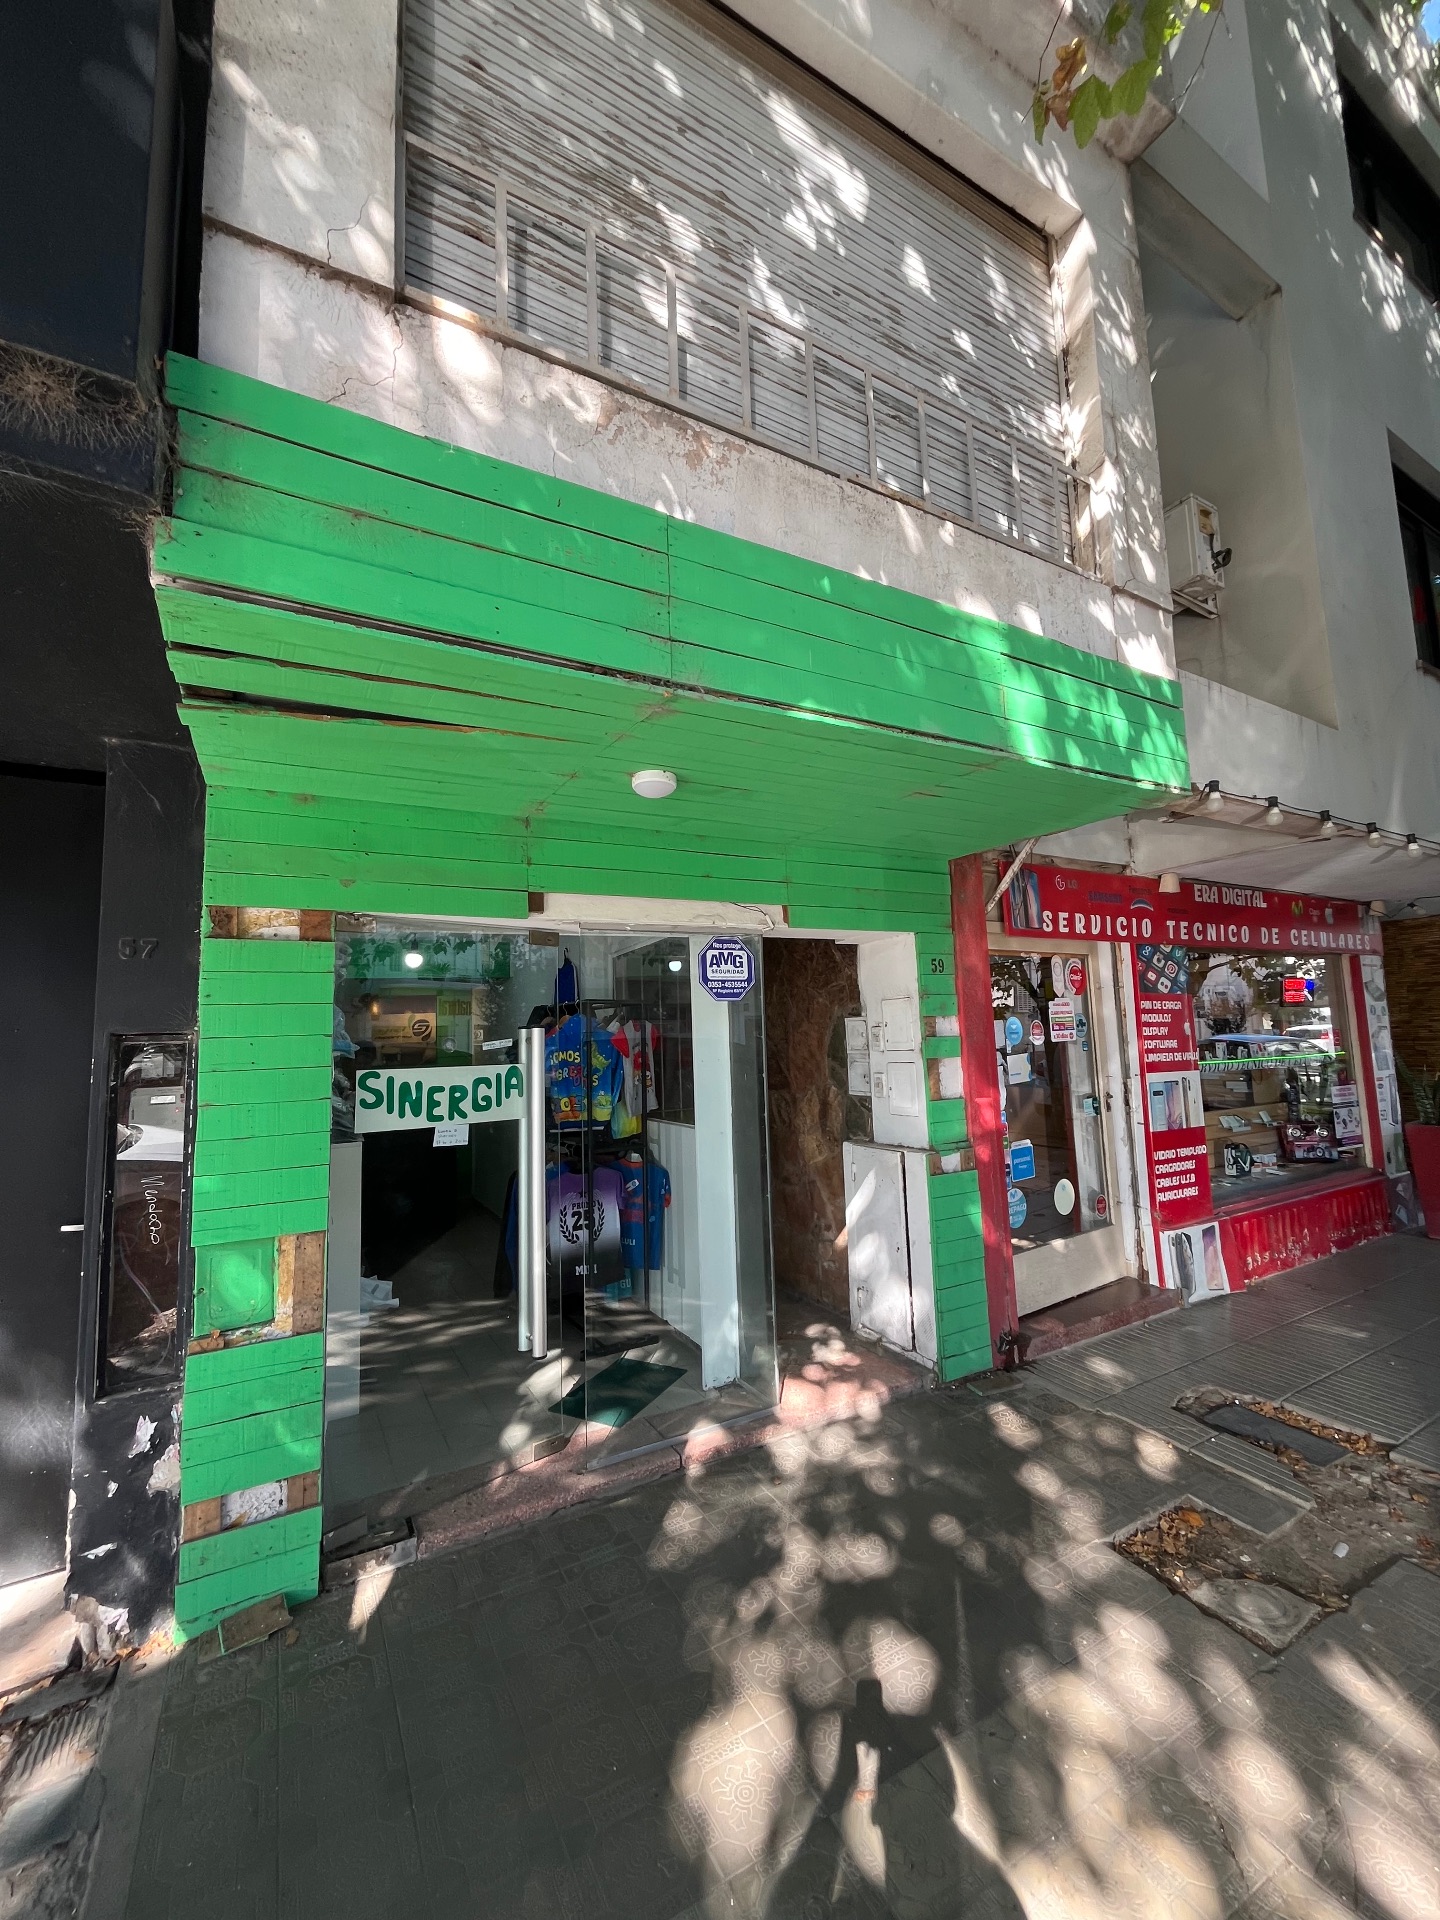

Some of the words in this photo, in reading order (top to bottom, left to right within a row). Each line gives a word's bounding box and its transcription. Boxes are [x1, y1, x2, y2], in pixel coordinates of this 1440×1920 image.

[1193, 883, 1218, 903] ERA
[1222, 887, 1267, 908] DIGITAL
[1042, 910, 1152, 938] SERVICIO
[1166, 920, 1250, 943] TECNICO
[1260, 927, 1280, 945] DE
[1290, 929, 1370, 950] CELULARES
[118, 936, 159, 960] 57
[709, 952, 744, 968] AMG
[931, 958, 945, 973] 59
[1140, 1000, 1152, 1010] PIN
[1152, 1000, 1162, 1010] DE
[1162, 1000, 1182, 1010] CARGA
[1141, 1013, 1171, 1023] MODULOS
[1142, 1026, 1169, 1036] DISPLAY
[1144, 1039, 1178, 1049] SOFTWARE
[1145, 1052, 1173, 1063] LIMPIEZA
[1173, 1052, 1183, 1061] DE
[358, 1065, 523, 1123] SINERGIA
[1153, 1149, 1176, 1160] VIDRIO
[1176, 1144, 1207, 1158] TEMPLADO
[1155, 1160, 1196, 1174] CARGADORES
[1156, 1175, 1180, 1188] CABLES
[1157, 1186, 1199, 1202] AURICULARES
